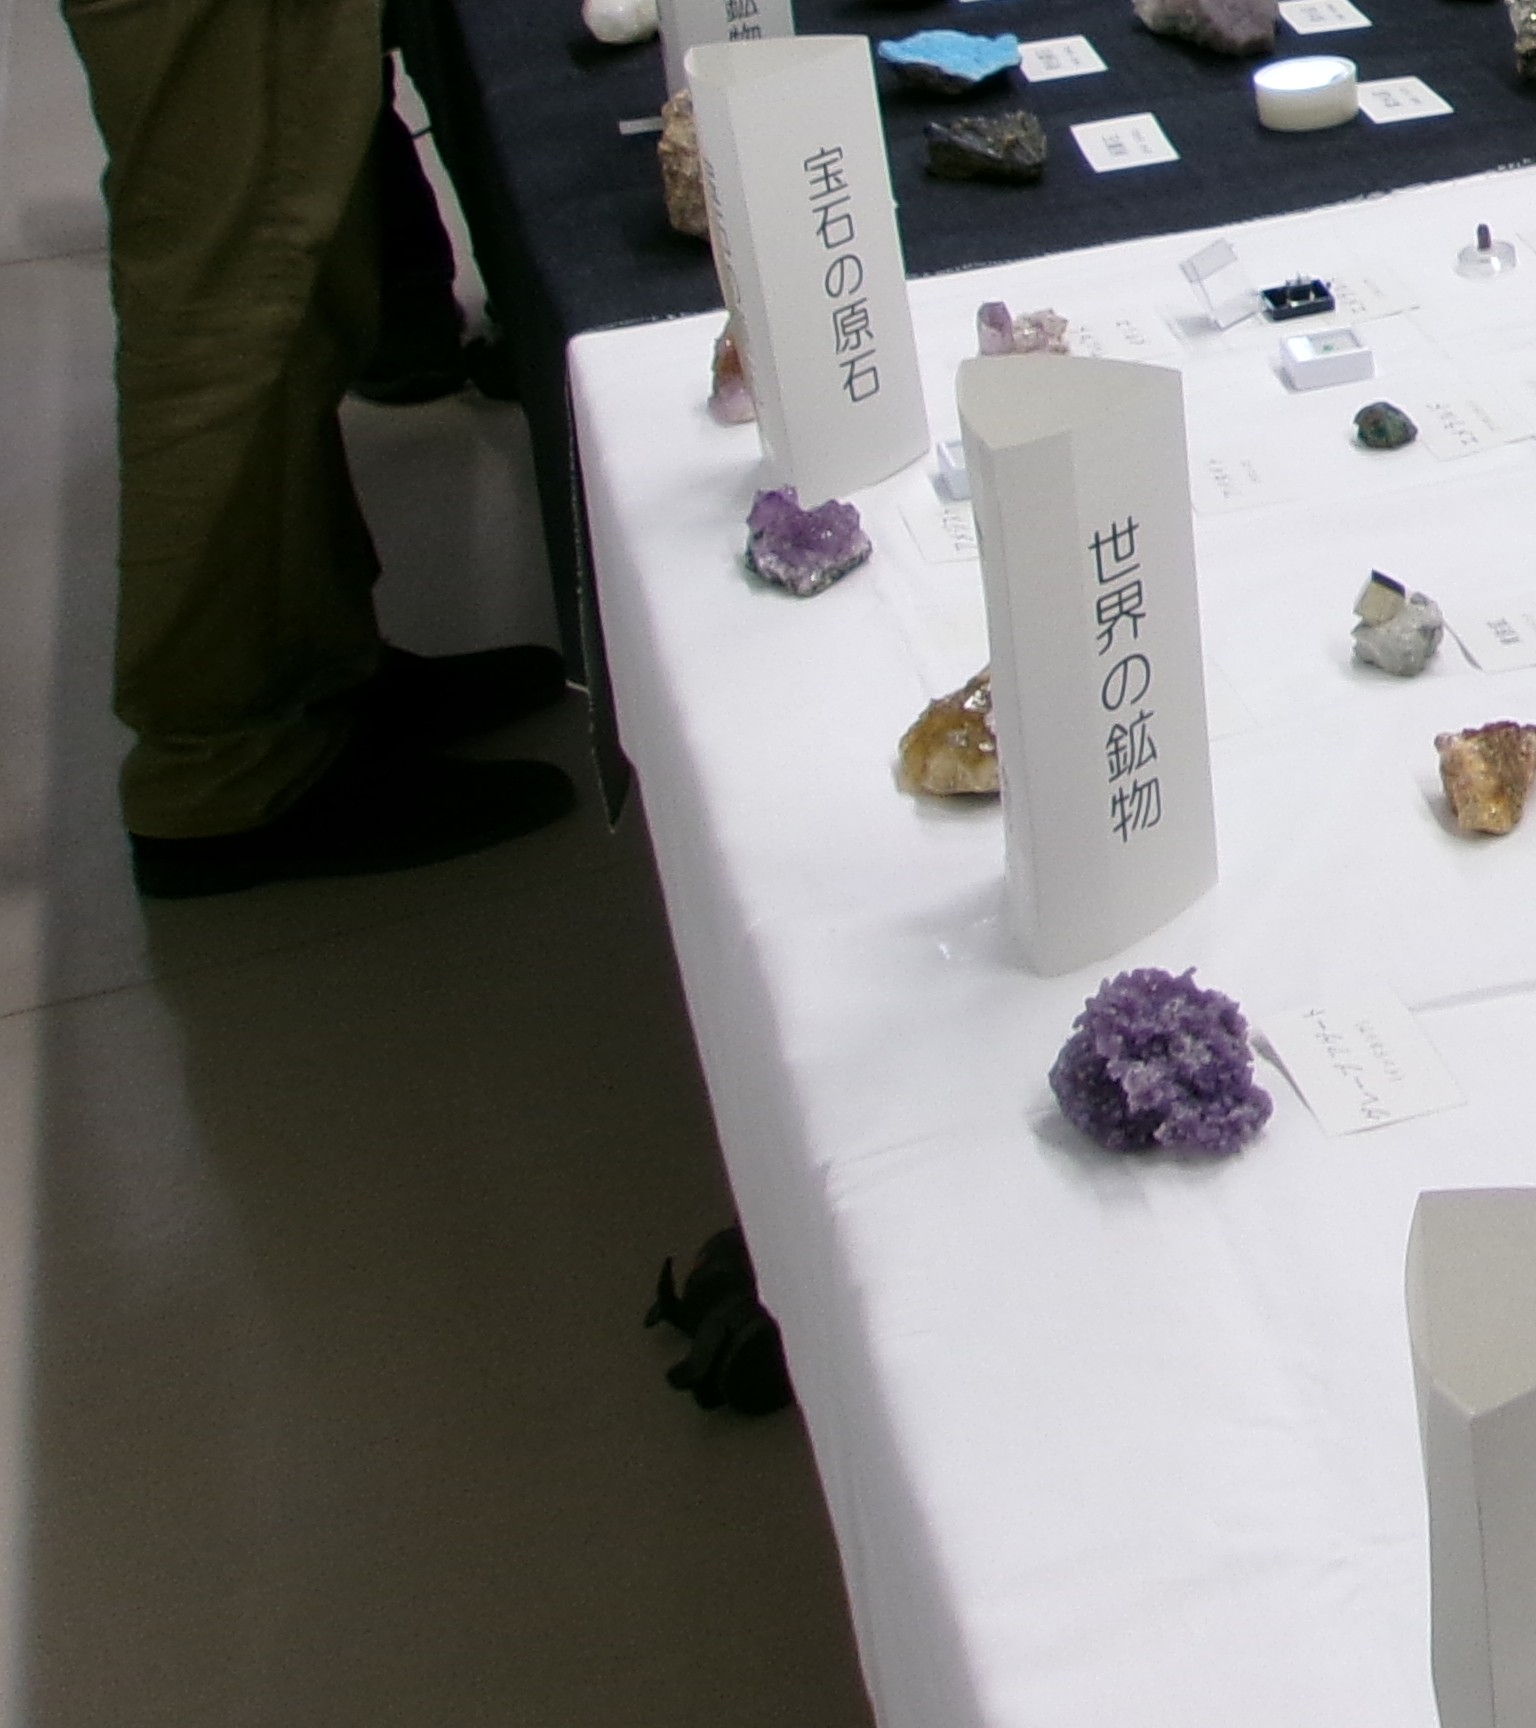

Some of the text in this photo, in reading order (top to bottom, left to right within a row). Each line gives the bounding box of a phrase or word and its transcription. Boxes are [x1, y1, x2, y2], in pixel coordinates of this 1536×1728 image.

[803, 146, 881, 403] 宝石の原石
[1088, 515, 1163, 843] 世界の鉱物
